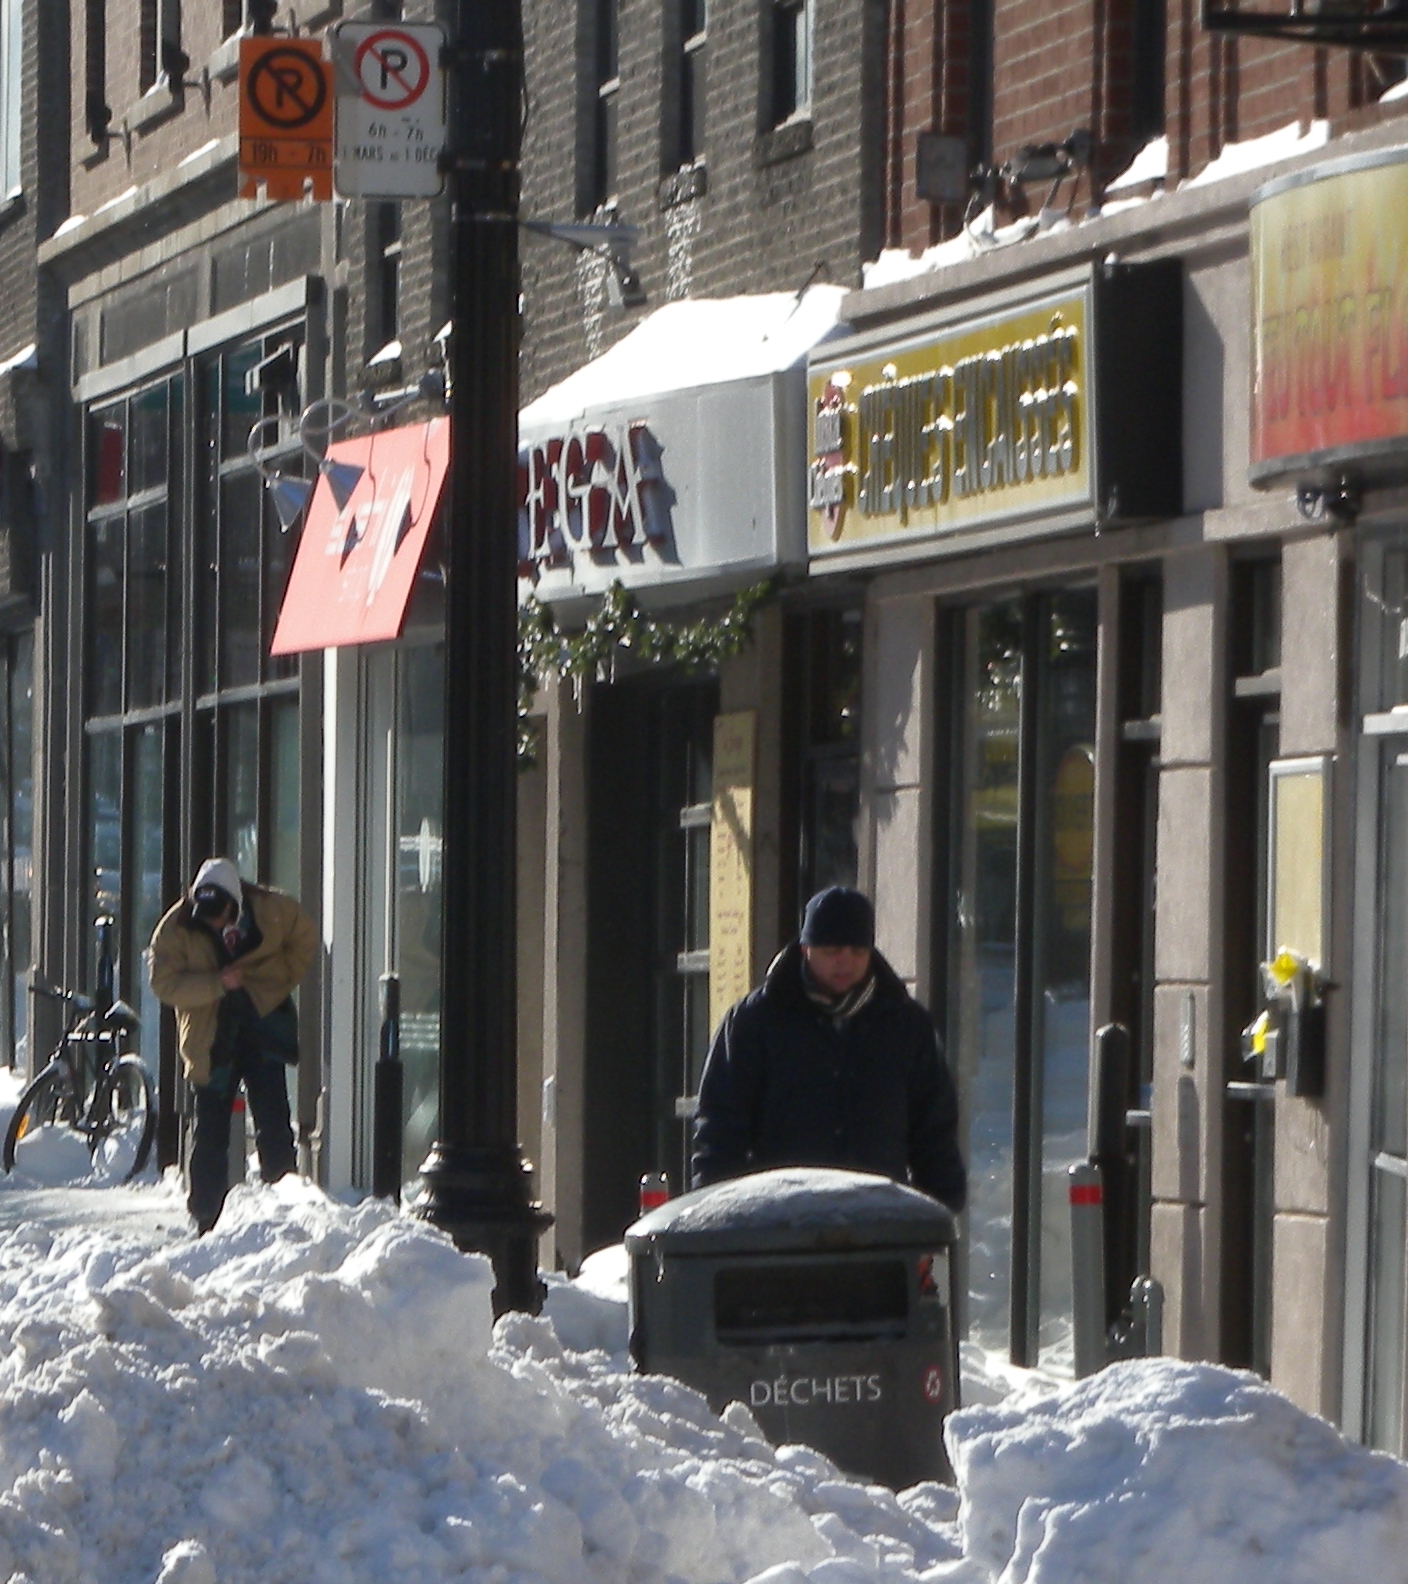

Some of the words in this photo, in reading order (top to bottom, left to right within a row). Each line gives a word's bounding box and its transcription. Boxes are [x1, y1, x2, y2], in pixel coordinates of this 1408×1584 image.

[368, 120, 387, 138] 6h
[406, 125, 424, 142] 7h
[252, 140, 278, 163] 19h
[307, 141, 327, 163] 7h
[353, 145, 383, 161] MARS
[749, 1375, 882, 1407] DÉCHETS
